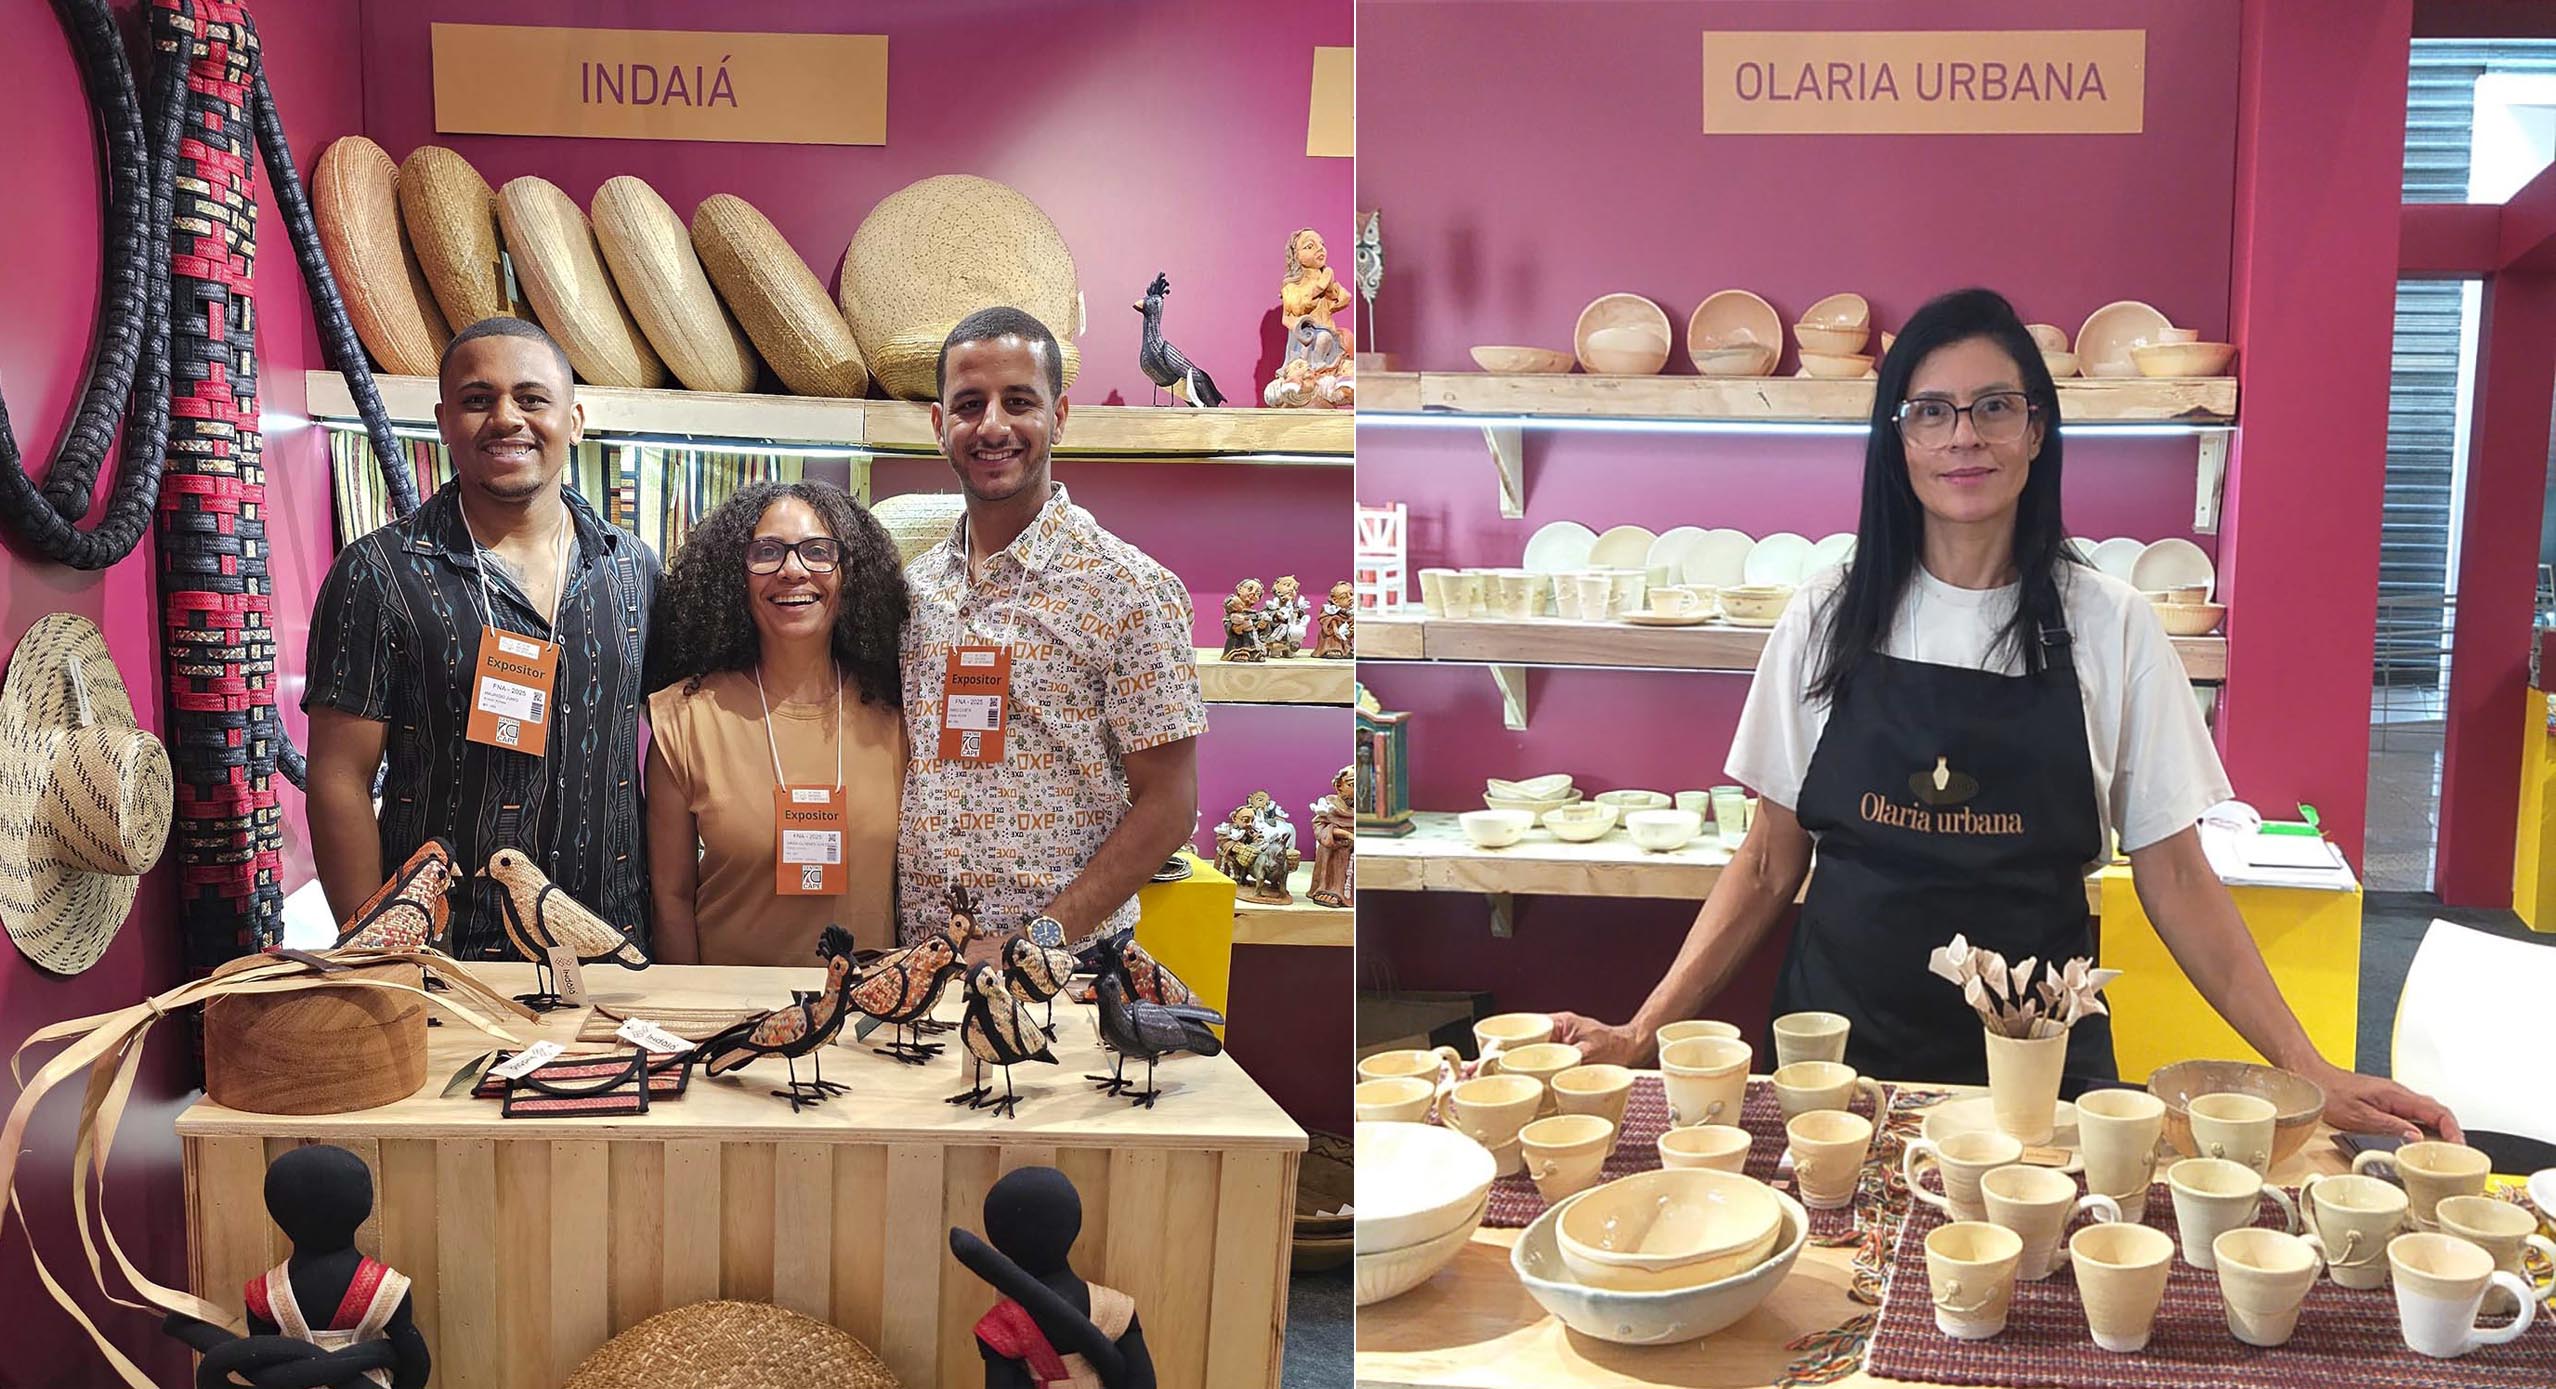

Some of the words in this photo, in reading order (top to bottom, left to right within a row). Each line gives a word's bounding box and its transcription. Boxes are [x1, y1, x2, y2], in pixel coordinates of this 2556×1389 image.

[582, 54, 738, 108] INDAIÁ
[1735, 61, 1900, 101] OLARIA
[1916, 61, 2107, 102] URBANA
[487, 656, 546, 678] Expositor
[952, 673, 1002, 687] Expositor
[785, 809, 839, 823] Expositor
[1860, 791, 1932, 833] Olaria
[1937, 806, 2024, 835] urbana
